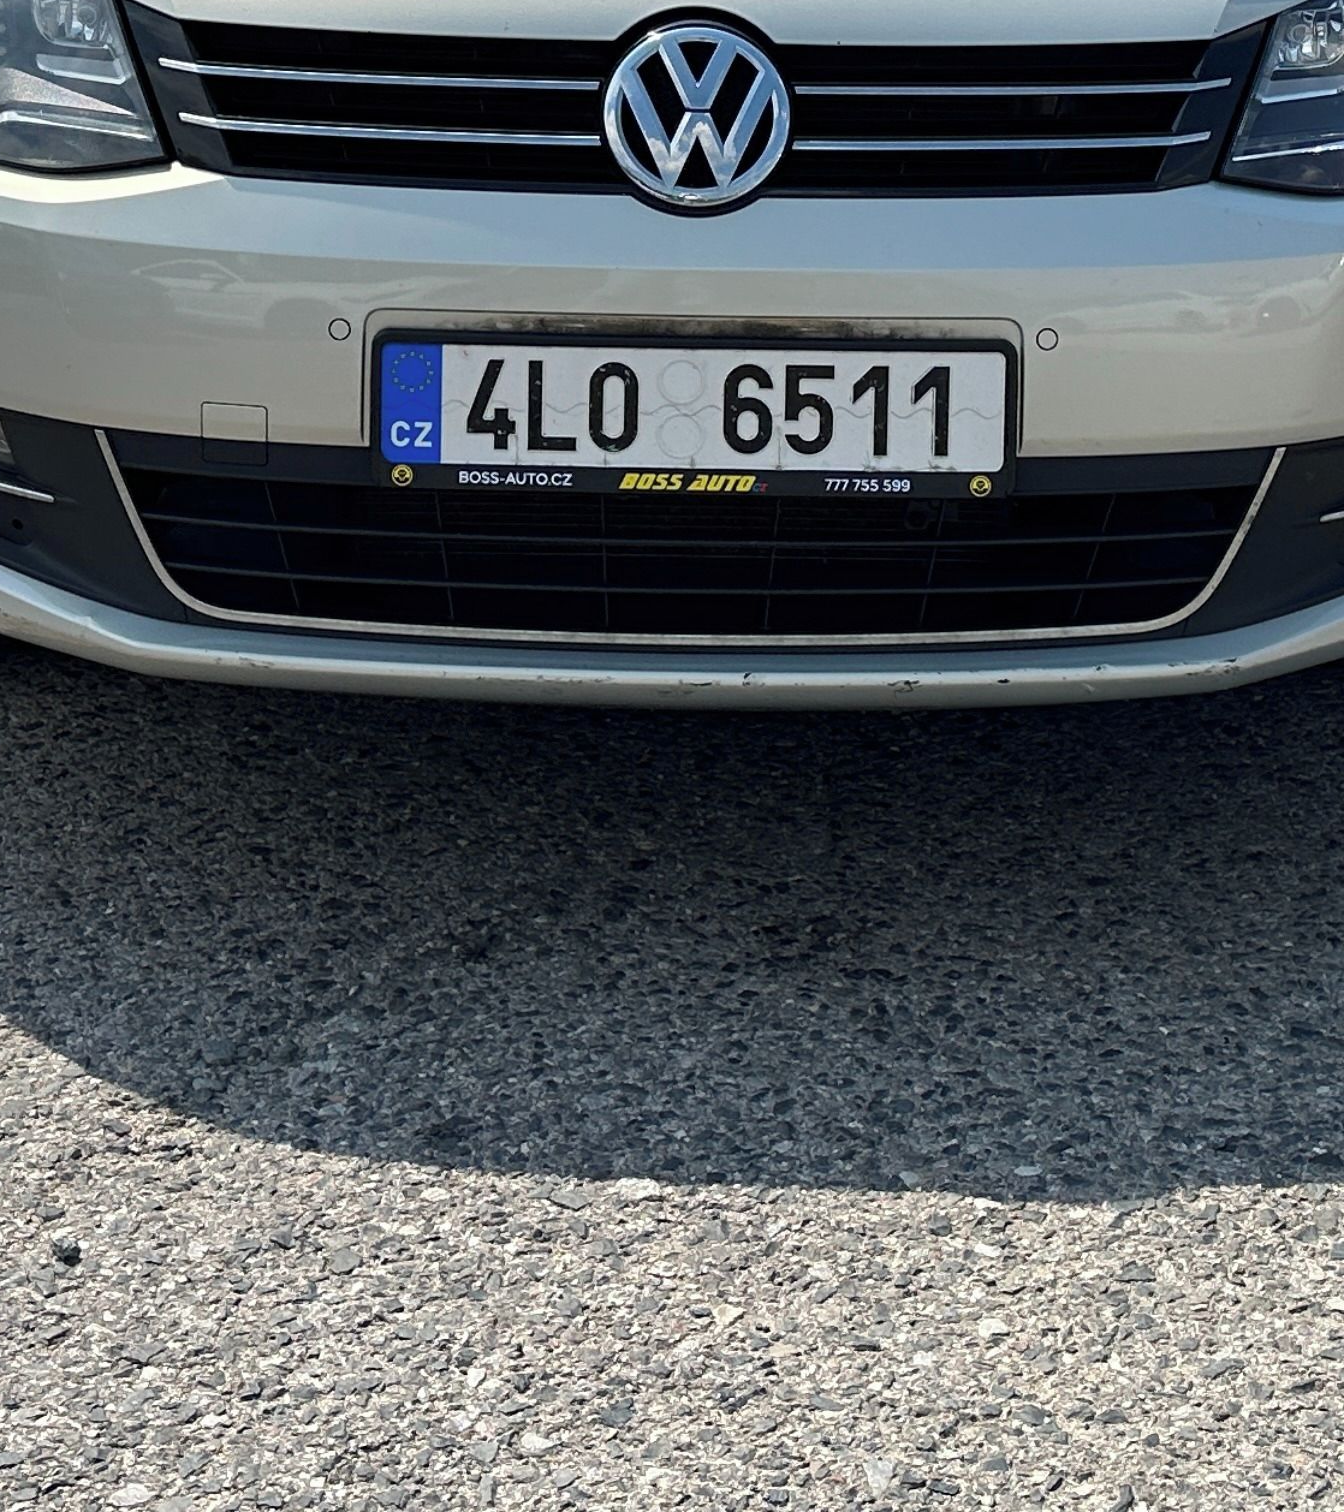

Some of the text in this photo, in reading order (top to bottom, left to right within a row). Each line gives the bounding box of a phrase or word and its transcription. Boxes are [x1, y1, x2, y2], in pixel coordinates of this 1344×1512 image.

[722, 363, 951, 457] 6511
[389, 420, 434, 450] CZ
[458, 470, 573, 487] BOSS-AUTO.CZ
[619, 472, 682, 491] BOSS
[686, 474, 757, 493] AUTO
[824, 478, 911, 493] 777 755 599
